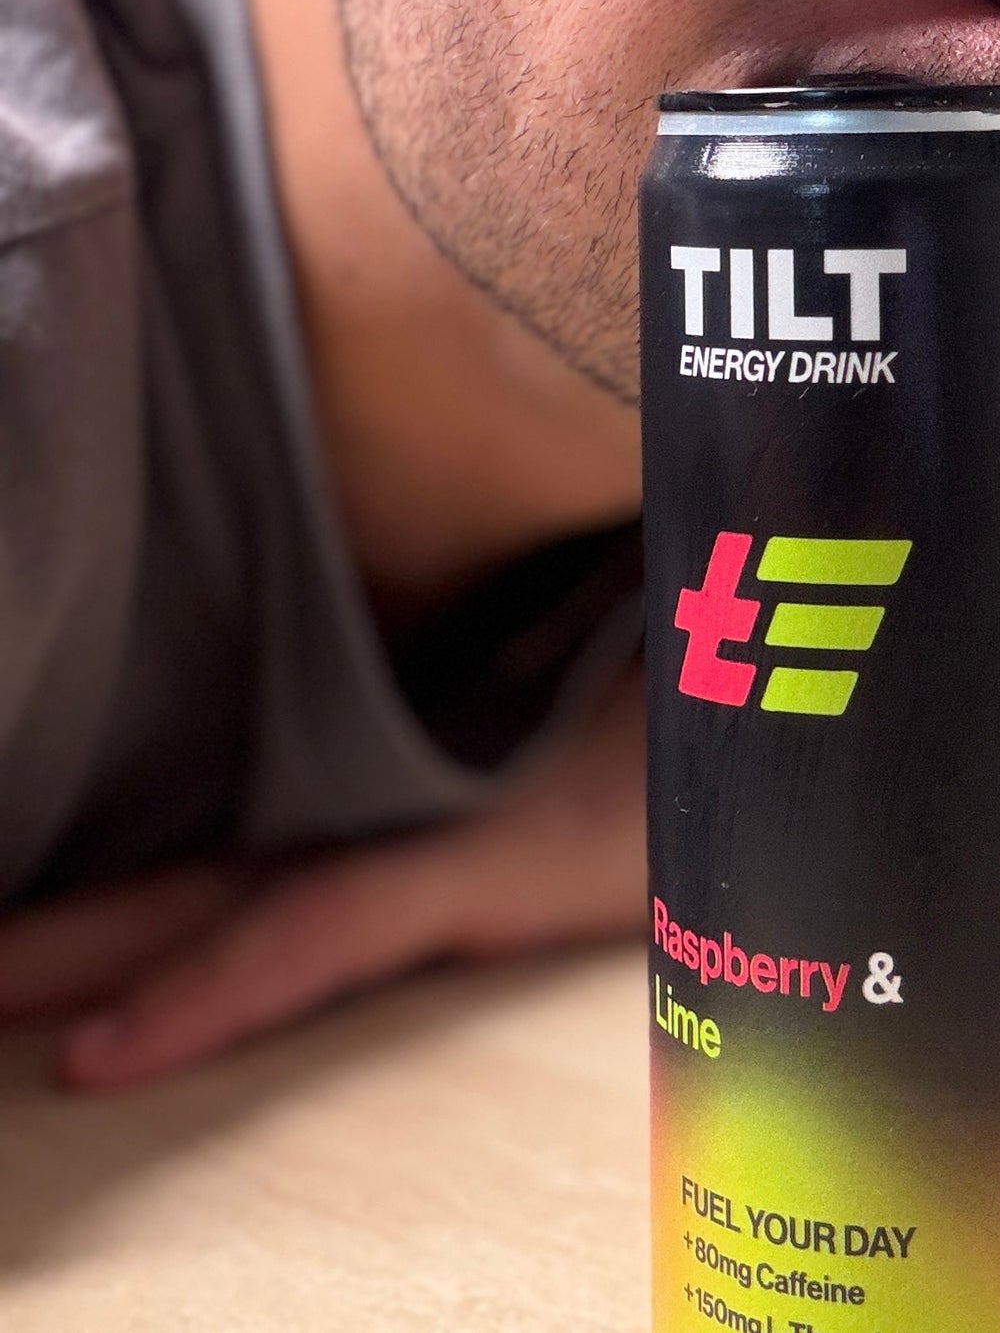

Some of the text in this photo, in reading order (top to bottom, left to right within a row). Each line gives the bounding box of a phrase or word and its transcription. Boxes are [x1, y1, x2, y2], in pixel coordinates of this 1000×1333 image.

[671, 245, 907, 341] TILT
[680, 344, 899, 384] ENERGY DRINK
[653, 895, 905, 1013] Raspberry &
[654, 973, 723, 1059] Lime
[682, 1174, 917, 1259] FUEL YOUR DAY
[683, 1230, 866, 1306] +80mg Caffeine
